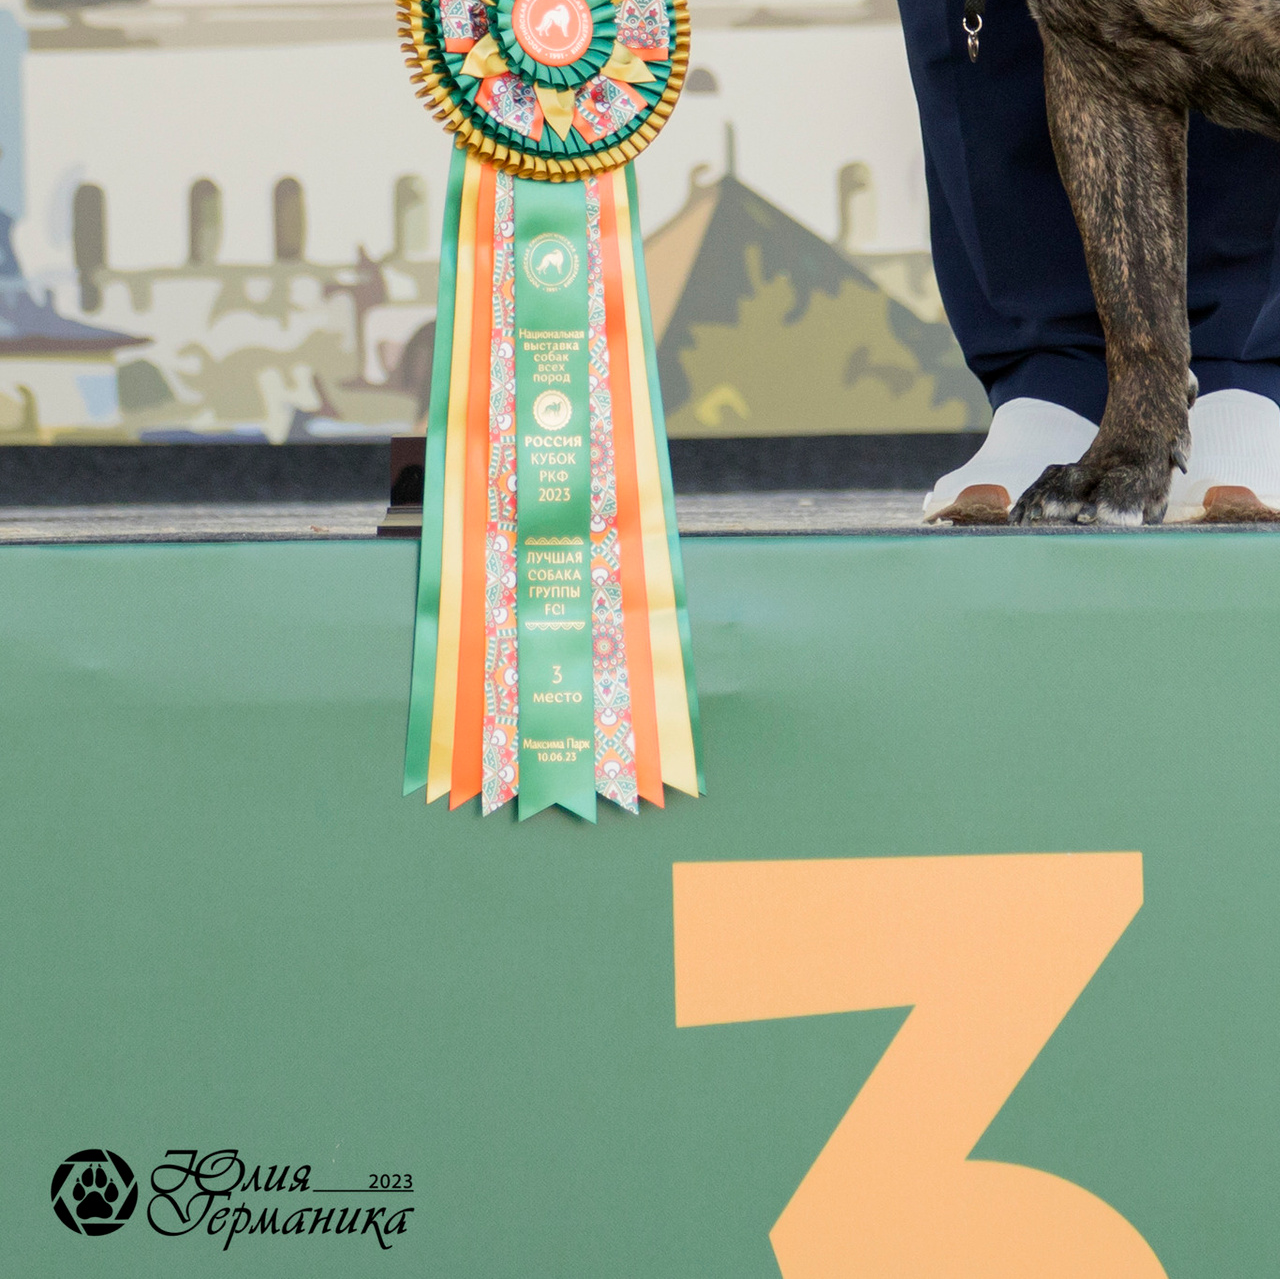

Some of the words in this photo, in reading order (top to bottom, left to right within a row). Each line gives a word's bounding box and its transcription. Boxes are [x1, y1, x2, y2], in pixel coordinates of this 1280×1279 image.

[519, 328, 585, 340] Национальная
[523, 342, 579, 351] выставка
[533, 351, 569, 362] собак
[538, 363, 565, 372] всех
[533, 373, 571, 385] пород
[524, 435, 582, 447] РОССИЯ
[531, 452, 576, 465] КУБОК
[539, 470, 569, 482] РКФ
[538, 487, 571, 502] 2023
[526, 551, 583, 564] ЛУЧШАЯ
[528, 569, 582, 581] СОБАКА
[529, 586, 580, 598] ГРУППЫ
[544, 603, 565, 616] FCI
[552, 665, 563, 684] 3
[533, 692, 583, 703] место
[523, 739, 565, 749] Максима
[566, 737, 590, 752] Парк
[537, 752, 577, 762] 10.06.23
[672, 851, 1170, 1279] 3
